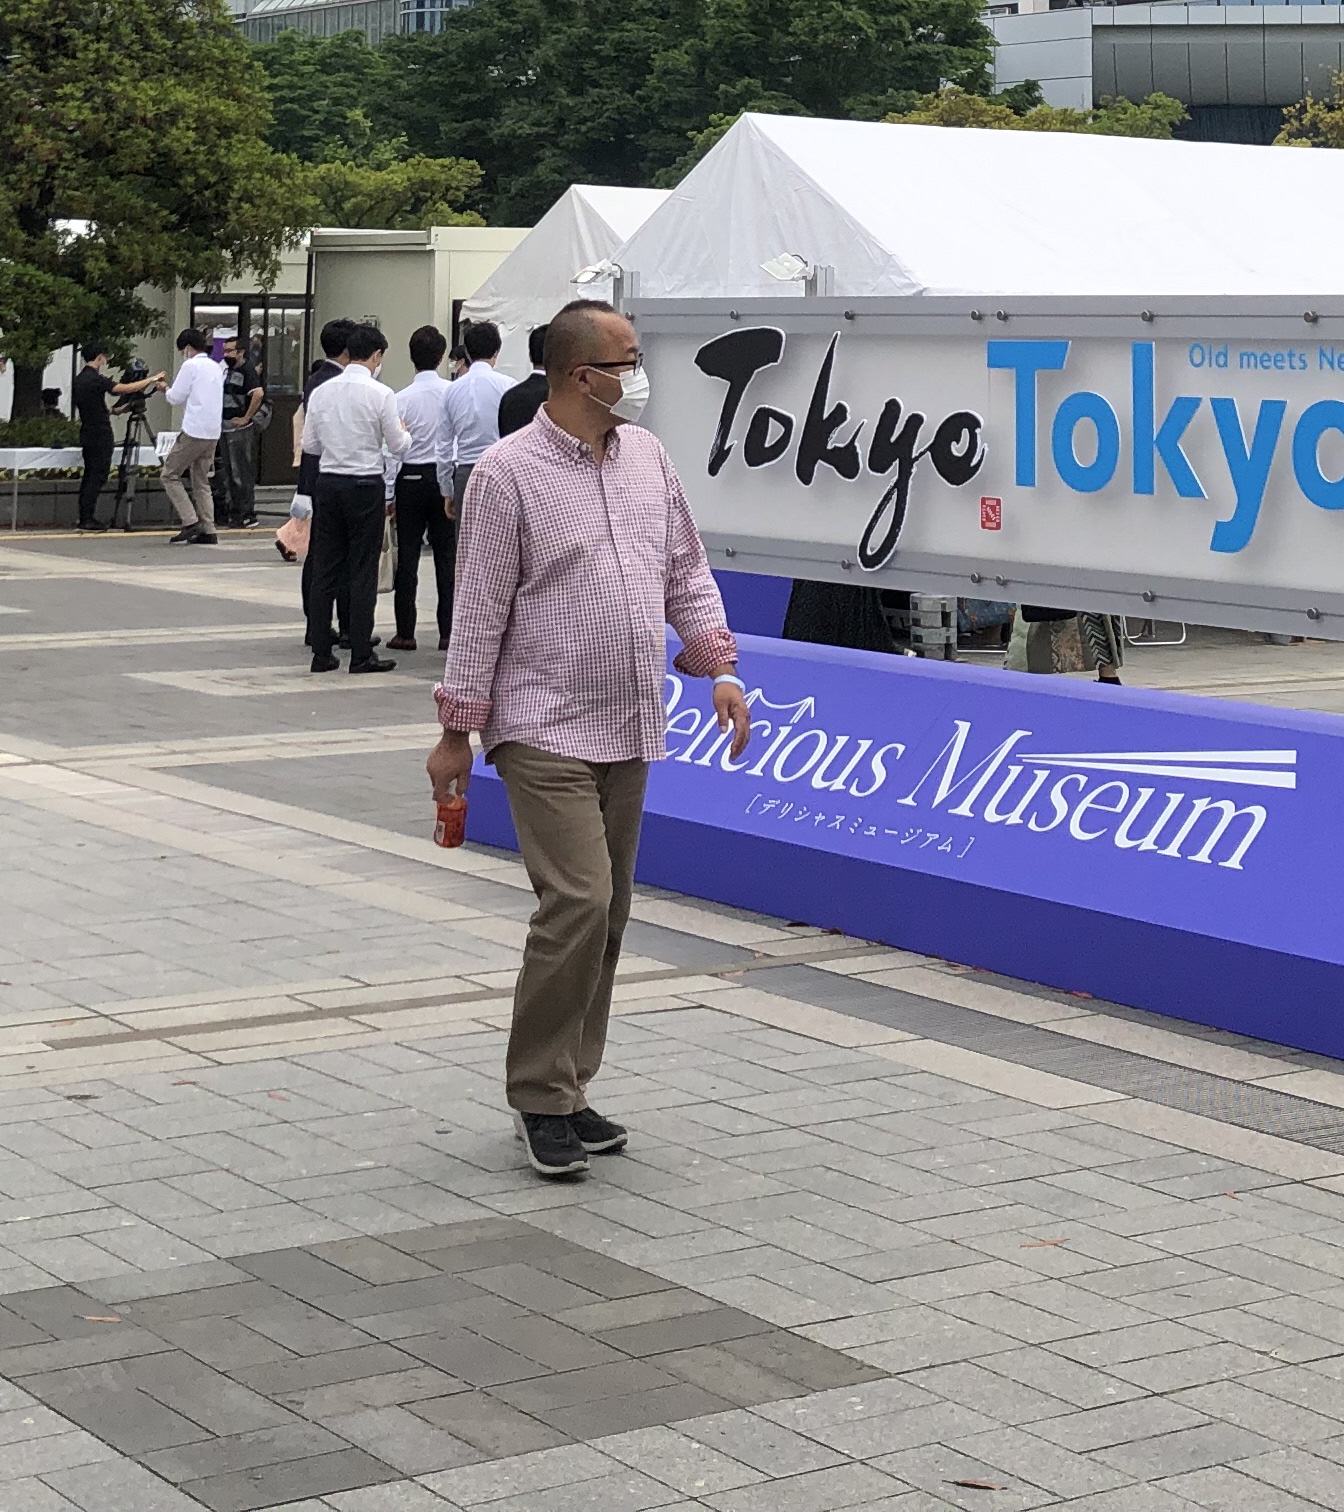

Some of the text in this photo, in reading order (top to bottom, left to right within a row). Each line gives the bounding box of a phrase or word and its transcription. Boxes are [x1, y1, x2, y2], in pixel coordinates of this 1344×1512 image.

[693, 326, 988, 572] Tokyo
[1189, 343, 1229, 369] Old
[1238, 348, 1307, 371] meets
[663, 674, 1268, 872] elicious Museum
